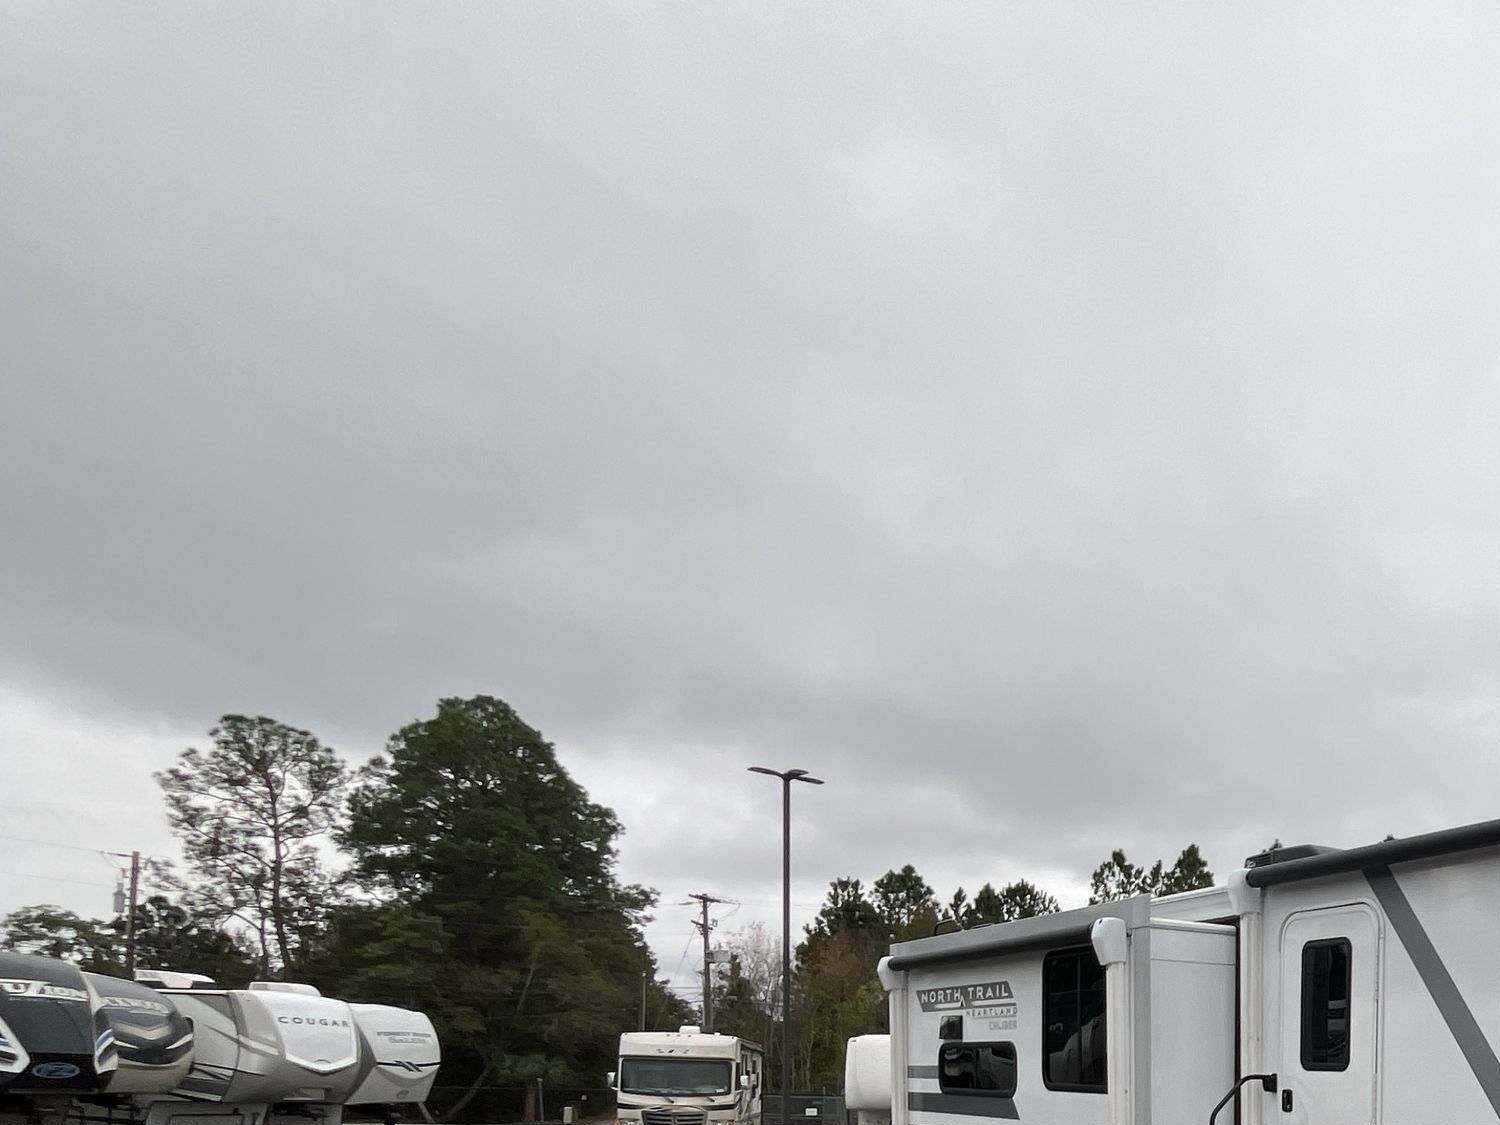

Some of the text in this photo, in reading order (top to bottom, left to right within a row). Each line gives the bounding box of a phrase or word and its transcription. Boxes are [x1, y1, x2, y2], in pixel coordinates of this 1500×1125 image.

[921, 984, 1009, 1004] NORTH TRAIL
[278, 1016, 350, 1028] COUGAR
